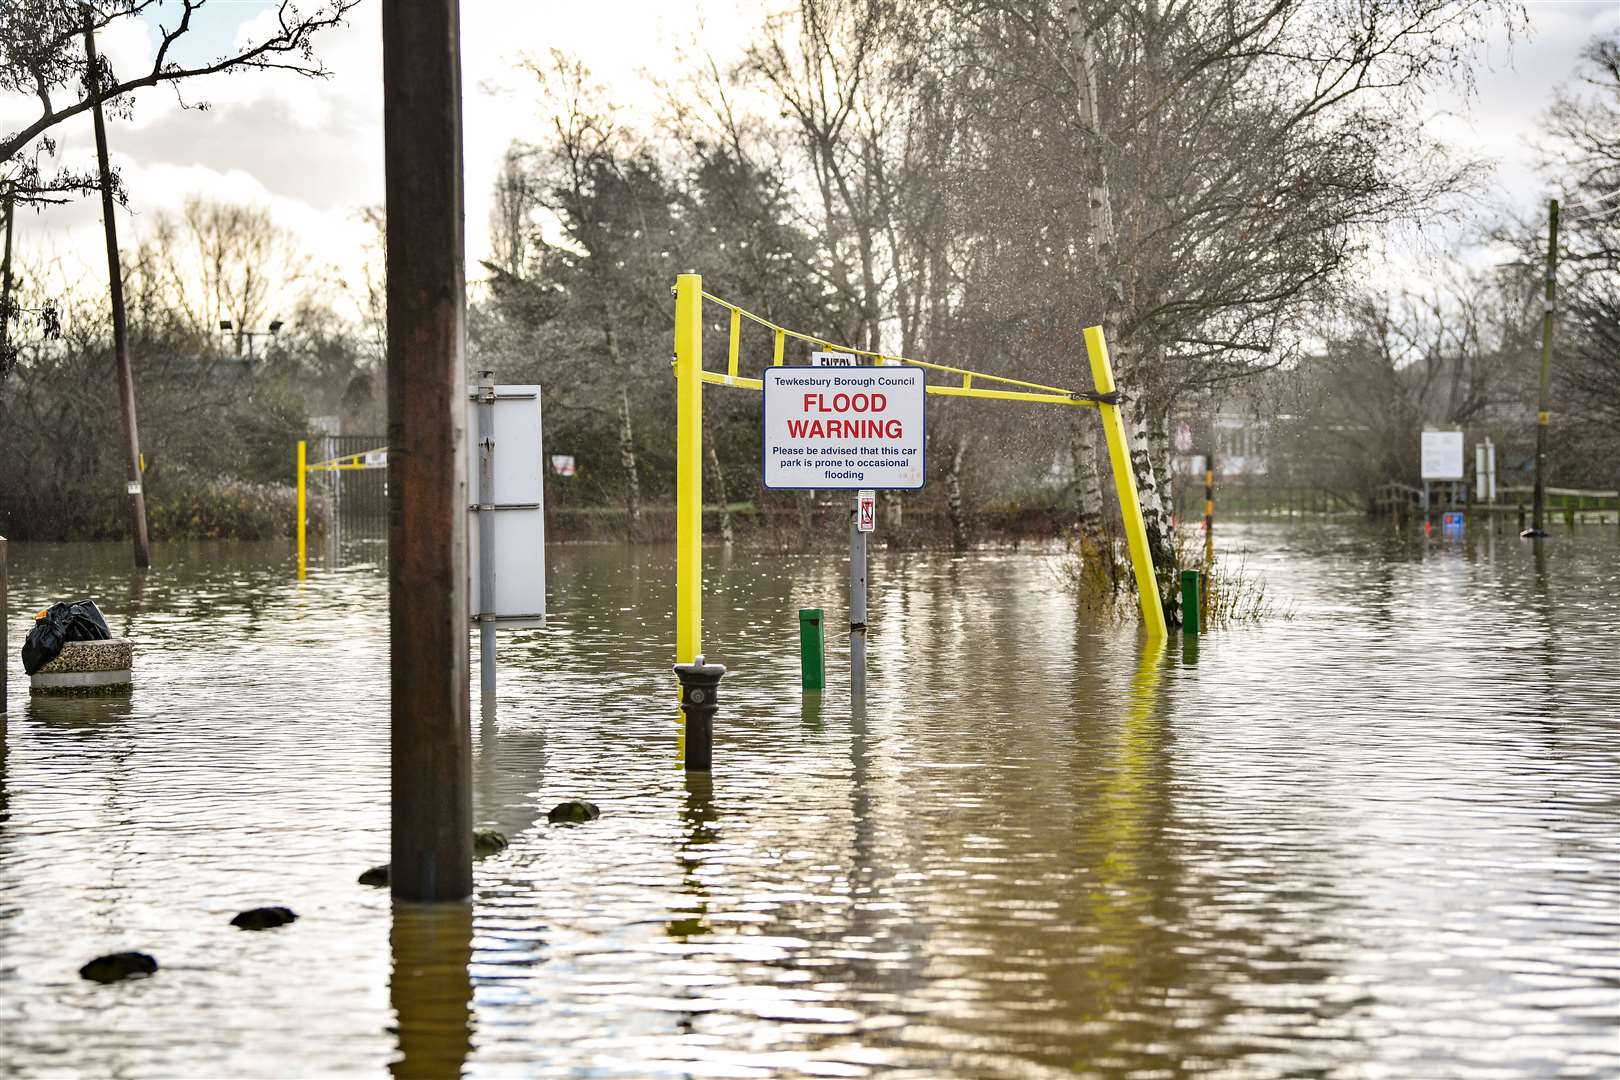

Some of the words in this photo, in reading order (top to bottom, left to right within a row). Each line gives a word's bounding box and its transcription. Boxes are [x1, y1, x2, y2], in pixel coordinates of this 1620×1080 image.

[775, 377, 831, 388] Tewkesbury
[834, 377, 875, 388] Borough
[878, 377, 915, 386] Council
[803, 393, 887, 413] FLOOD
[787, 419, 903, 439] WARNING
[772, 446, 804, 455] Please
[806, 446, 818, 455] be
[820, 446, 858, 455] advised
[860, 446, 879, 455] that
[881, 446, 899, 455] this
[780, 459, 802, 469] park
[804, 459, 812, 467] is
[815, 460, 842, 469] prone
[845, 459, 855, 467] to
[857, 459, 909, 467] occasional
[824, 470, 864, 480] flooding
